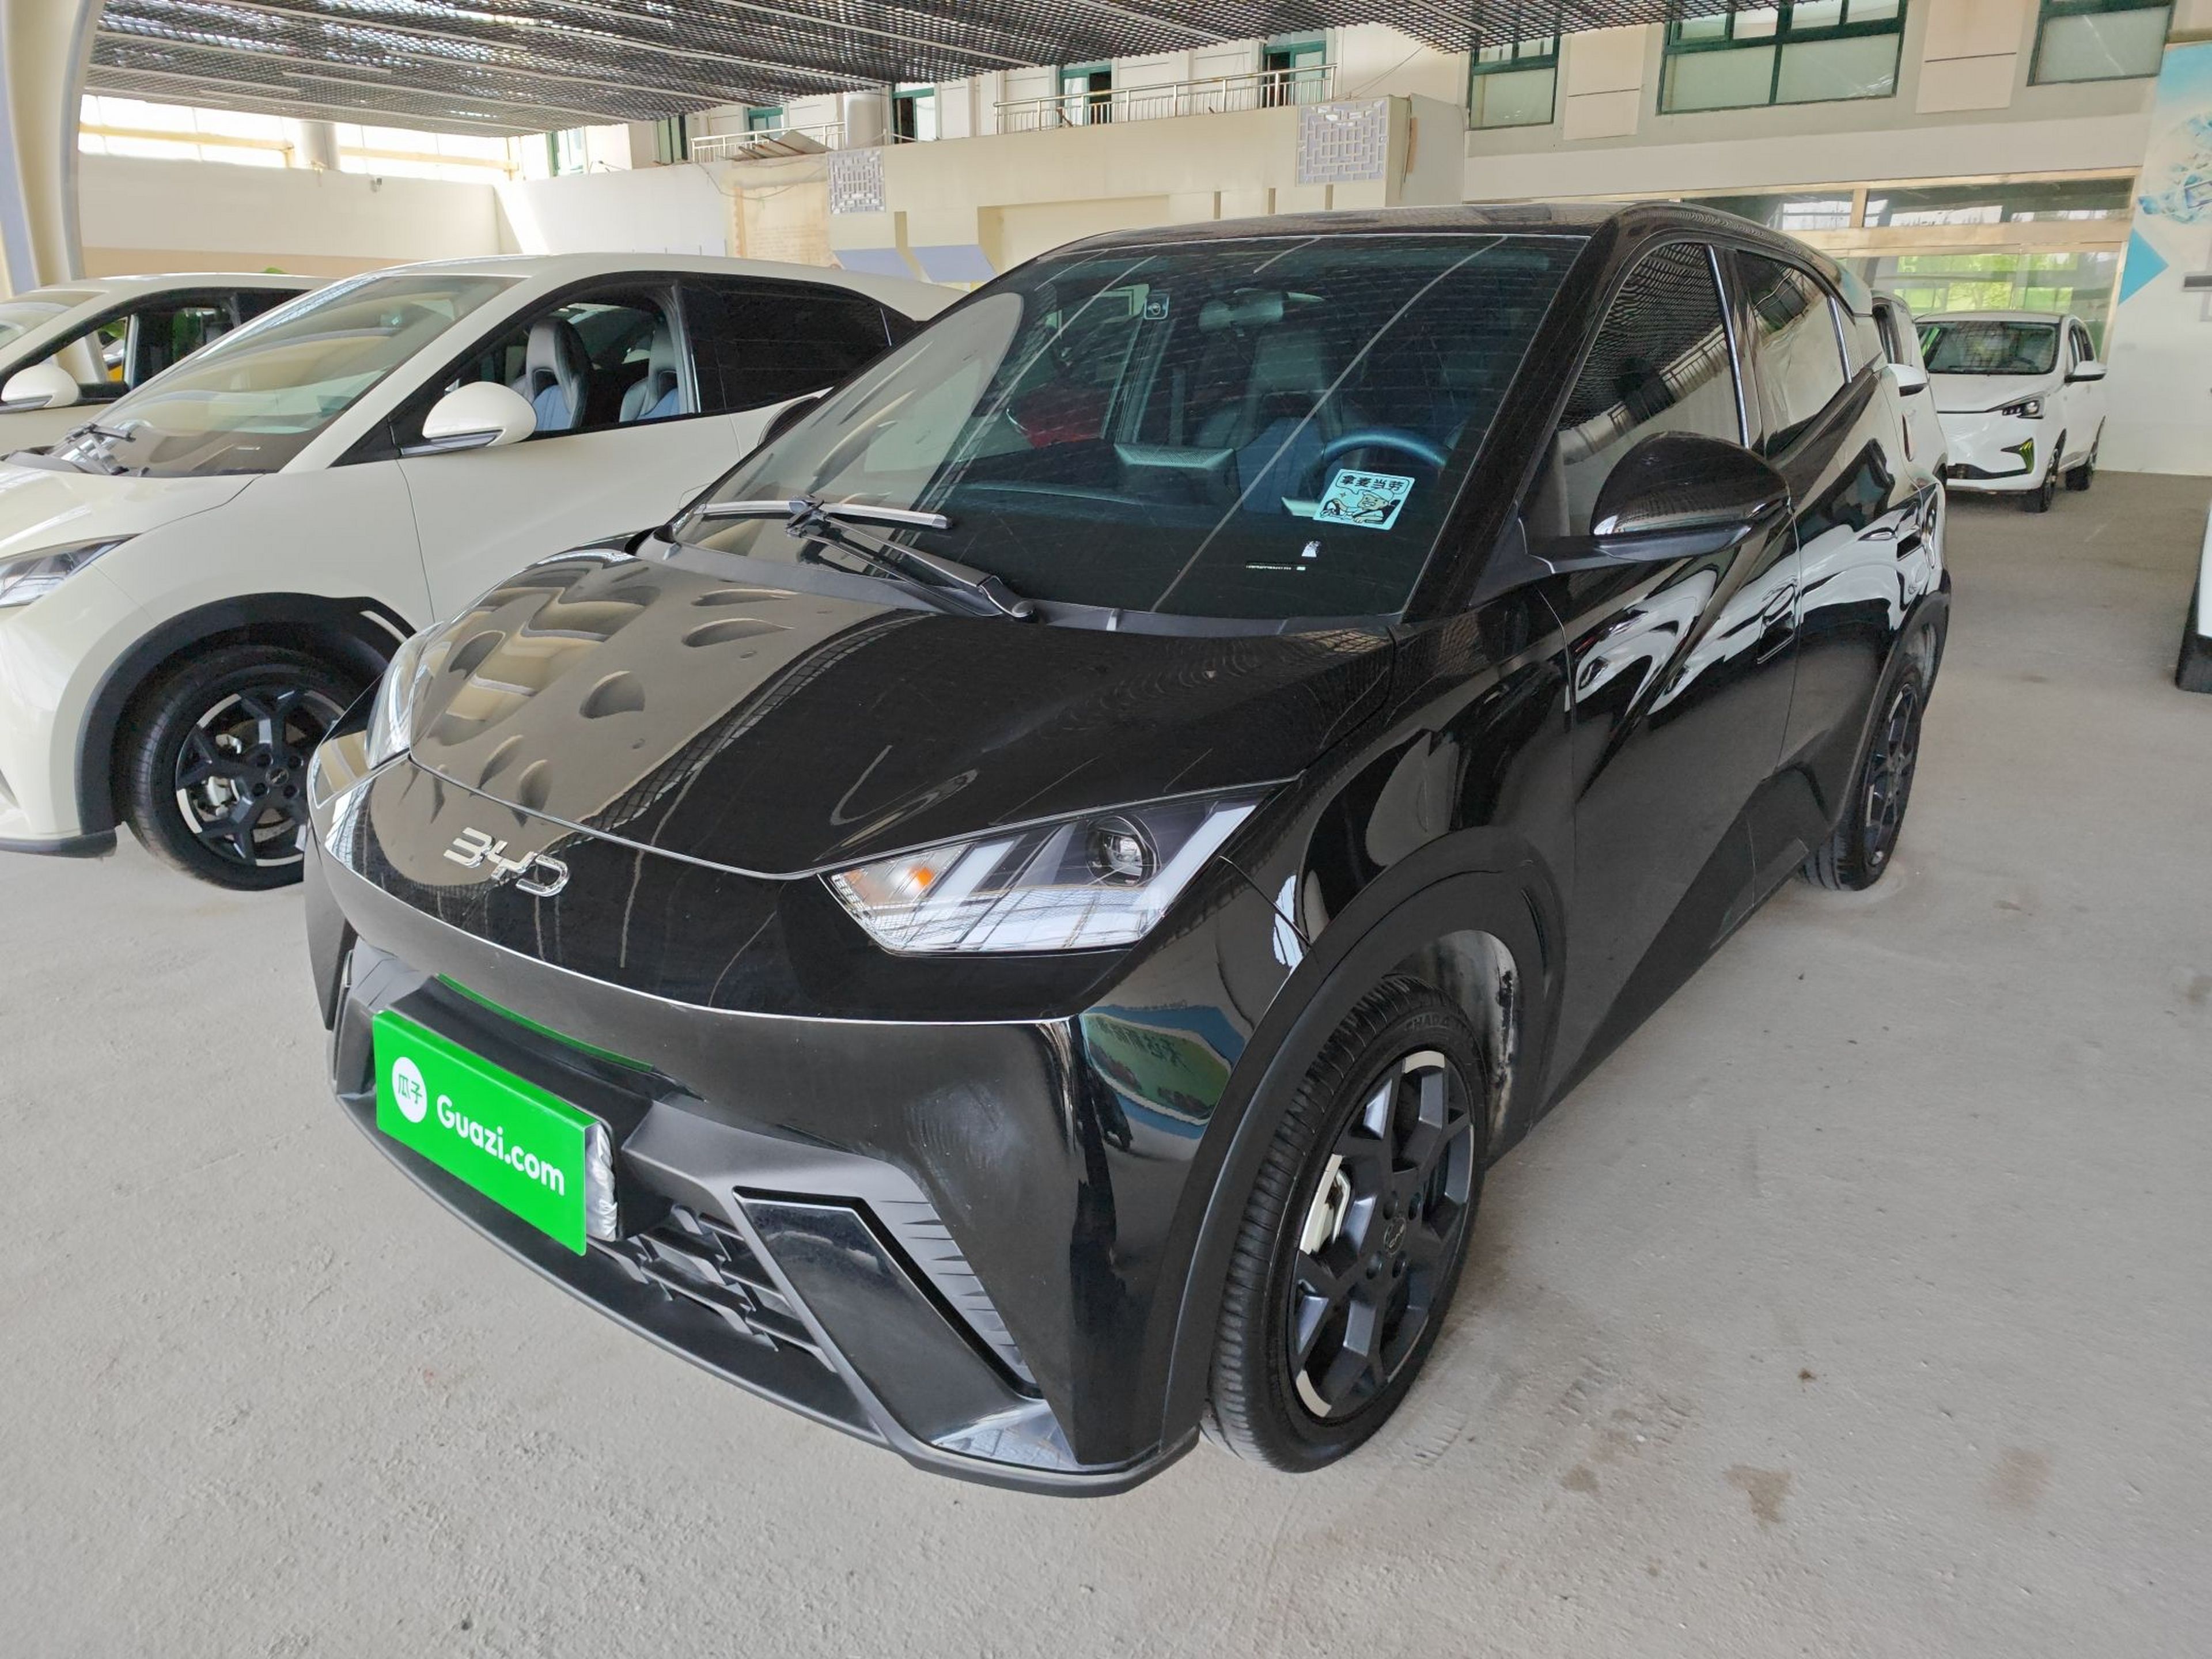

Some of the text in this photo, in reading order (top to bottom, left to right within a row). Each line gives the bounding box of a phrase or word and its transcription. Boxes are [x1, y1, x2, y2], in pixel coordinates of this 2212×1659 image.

[443, 827, 569, 896] BYD
[398, 1074, 423, 1104] 瓜子
[437, 1094, 565, 1196] Guazi.com
